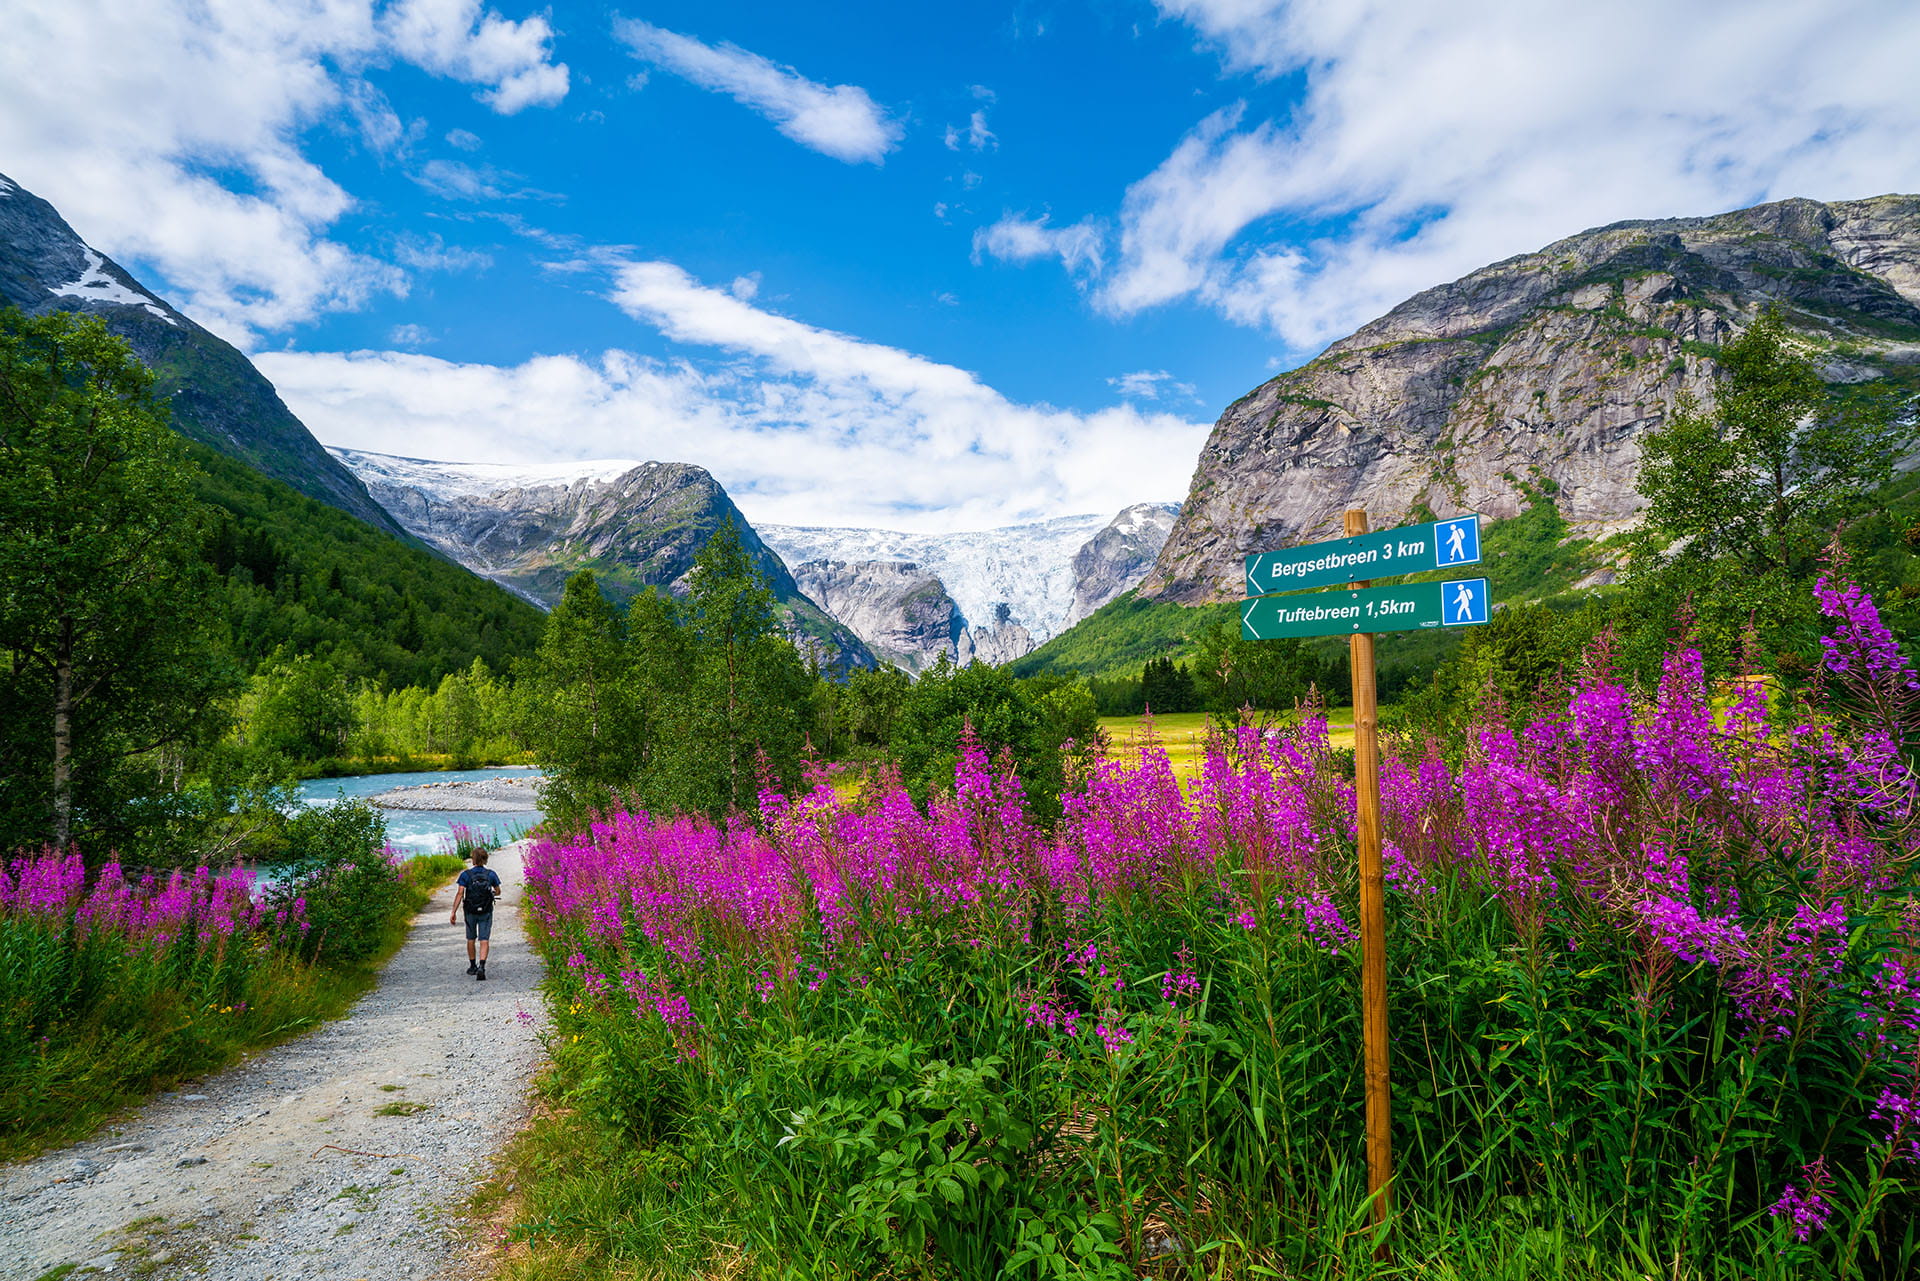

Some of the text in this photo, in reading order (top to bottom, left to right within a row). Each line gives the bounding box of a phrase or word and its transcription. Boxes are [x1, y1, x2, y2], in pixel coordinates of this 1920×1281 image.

[1271, 540, 1425, 578] Bergsetbreen 3 km
[1276, 599, 1416, 623] Tuftebreen 1,5km
